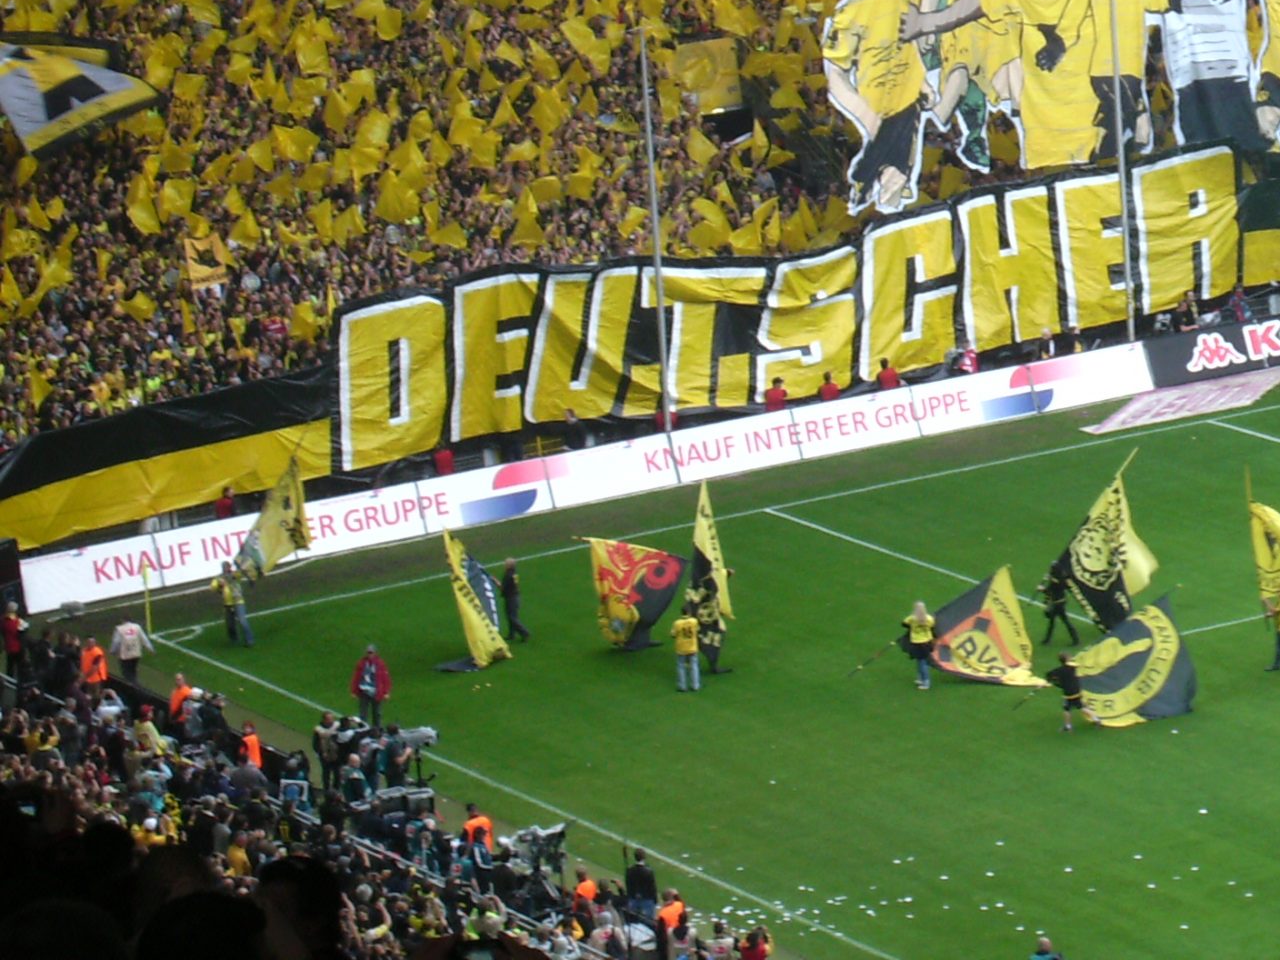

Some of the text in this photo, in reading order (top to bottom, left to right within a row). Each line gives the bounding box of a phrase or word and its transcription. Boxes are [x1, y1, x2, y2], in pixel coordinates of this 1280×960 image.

[339, 145, 1240, 473] DEUTSCHER
[643, 390, 971, 474] KNAUF INTERFER GRUPPE
[92, 542, 193, 584] KNAUF
[343, 492, 451, 534] GRUPPE
